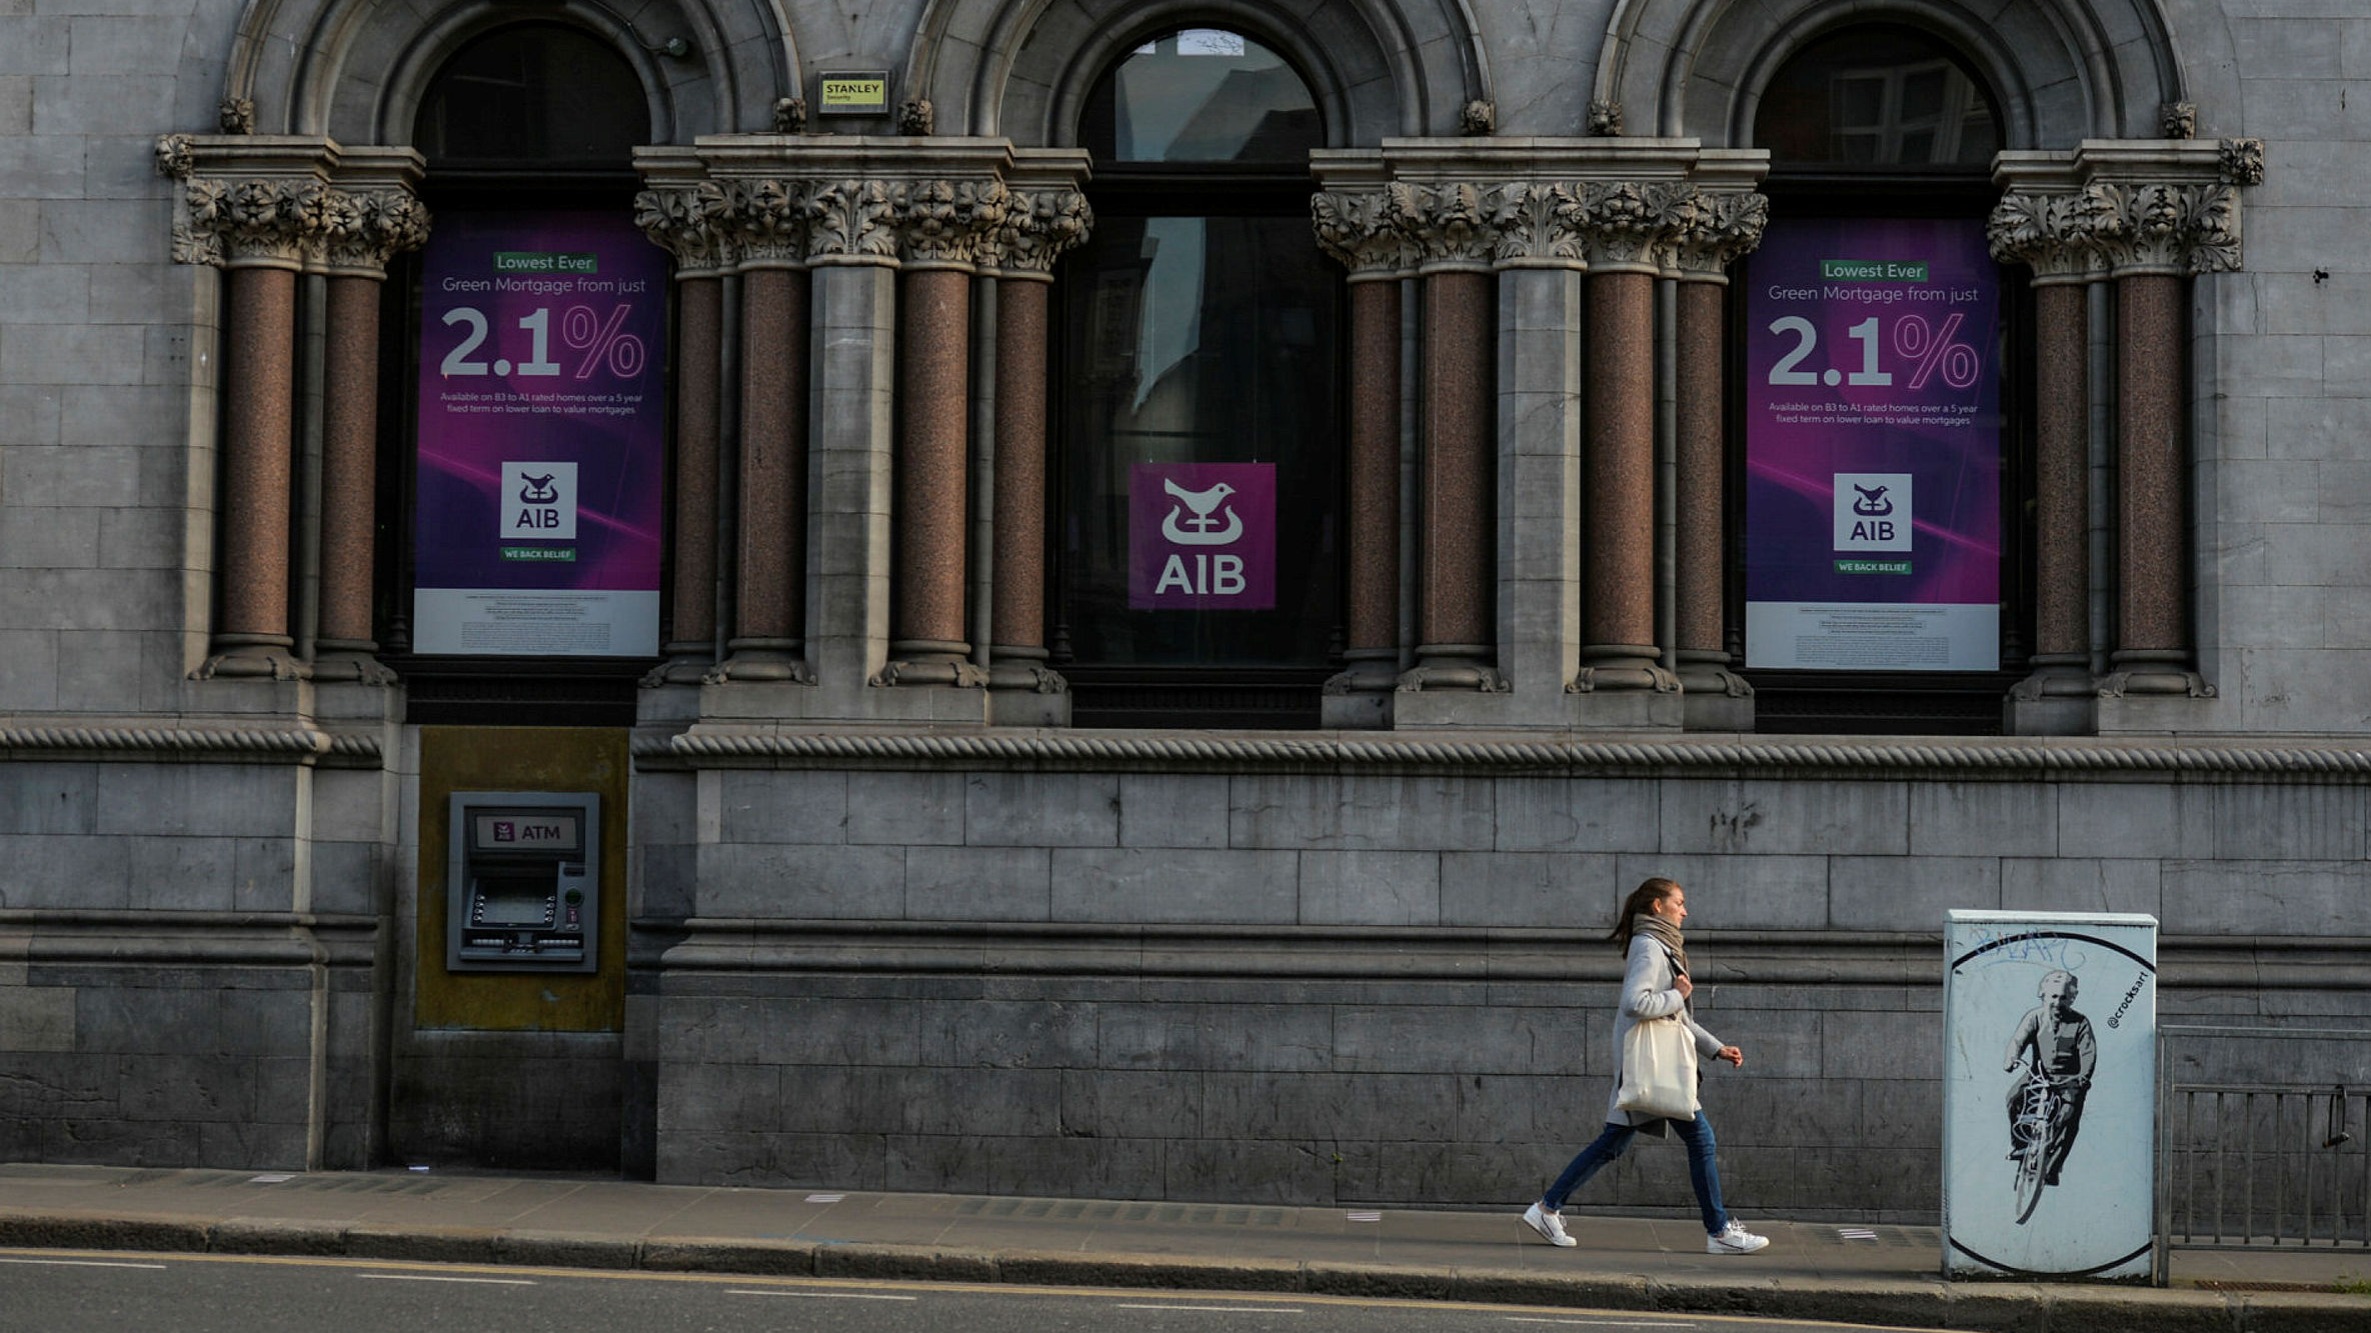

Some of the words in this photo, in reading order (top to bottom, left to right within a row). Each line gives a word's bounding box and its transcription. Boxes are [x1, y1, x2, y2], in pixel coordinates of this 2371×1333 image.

[826, 84, 879, 93] STANLEY
[498, 256, 553, 269] Lowest
[558, 256, 592, 269] Ever
[1825, 263, 1883, 278] Lowest
[1888, 264, 1922, 278] Ever
[442, 277, 491, 292] Green
[495, 278, 573, 295] Mortgage
[577, 278, 614, 293] from
[618, 279, 646, 296] just
[1768, 285, 1818, 300] Green
[1823, 286, 1903, 304] Mortgage
[1907, 286, 1945, 301] from
[1949, 287, 1979, 304] just
[440, 304, 645, 380] 2.1%
[1768, 313, 1979, 389] 2.1%
[440, 392, 479, 401] Available
[508, 393, 517, 401] to
[531, 393, 555, 402] rated
[556, 393, 586, 402] homes
[616, 393, 622, 402] 5
[623, 395, 643, 404] year
[447, 404, 469, 413] fixed
[469, 405, 491, 413] term
[492, 405, 504, 413] on
[505, 404, 530, 413] lower
[531, 405, 551, 413] loan
[552, 405, 561, 413] to
[563, 404, 587, 414] value
[588, 406, 636, 416] mortgages
[1769, 402, 1809, 411] Available
[1811, 404, 1823, 412] on
[1839, 404, 1849, 412] to
[1863, 404, 1888, 412] rated
[1889, 404, 1920, 413] homes
[1921, 405, 1941, 413] over
[1942, 405, 1949, 413] a
[1950, 404, 1957, 413] 5
[1958, 406, 1978, 415] year
[1776, 414, 1798, 423] fixed
[1800, 415, 1821, 423] term
[1836, 415, 1861, 424] lower
[1863, 415, 1884, 424] loan
[1885, 416, 1895, 424] to
[1896, 415, 1921, 425] value
[1922, 416, 1971, 427] mortgages
[516, 508, 559, 529] AIB
[1850, 521, 1896, 541] AIB
[504, 550, 518, 558] WE
[519, 550, 542, 558] BACK
[543, 550, 571, 559] BELIEF
[1154, 554, 1246, 595] AIB
[1838, 563, 1853, 571] WE
[1854, 563, 1878, 571] BACK
[1879, 563, 1907, 572] BELIEF
[521, 825, 561, 840] ATM
[2107, 971, 2149, 1029] @crocksart
